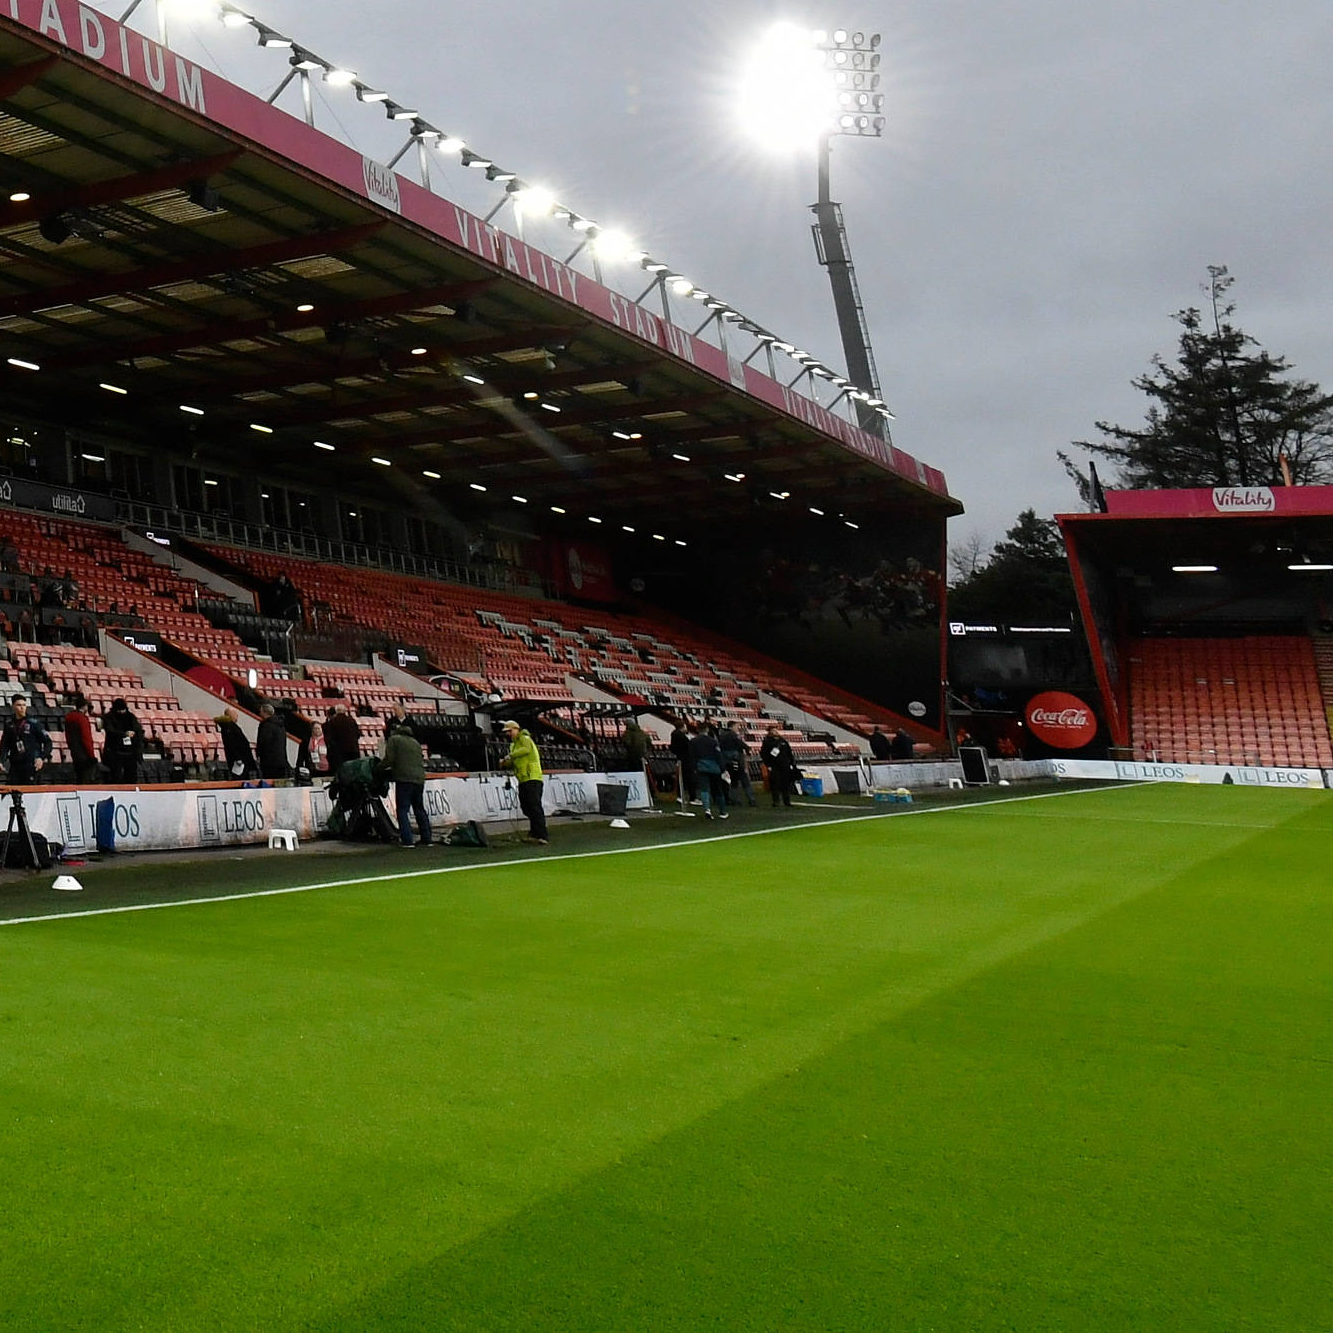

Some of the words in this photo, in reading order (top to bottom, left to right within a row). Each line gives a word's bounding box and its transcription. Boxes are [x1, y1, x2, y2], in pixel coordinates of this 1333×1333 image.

[364, 160, 400, 212] Vitality
[453, 206, 578, 305] VITALITY
[610, 291, 694, 364] STADUM
[52, 494, 78, 512] utilita
[1215, 489, 1272, 510] Vitality
[1031, 708, 1087, 725] Coca-Cola
[1142, 766, 1185, 779] LEOS
[1265, 770, 1311, 784] LEOS
[496, 786, 520, 812] LEO
[88, 804, 140, 839] LOS
[222, 800, 265, 833] LEOS
